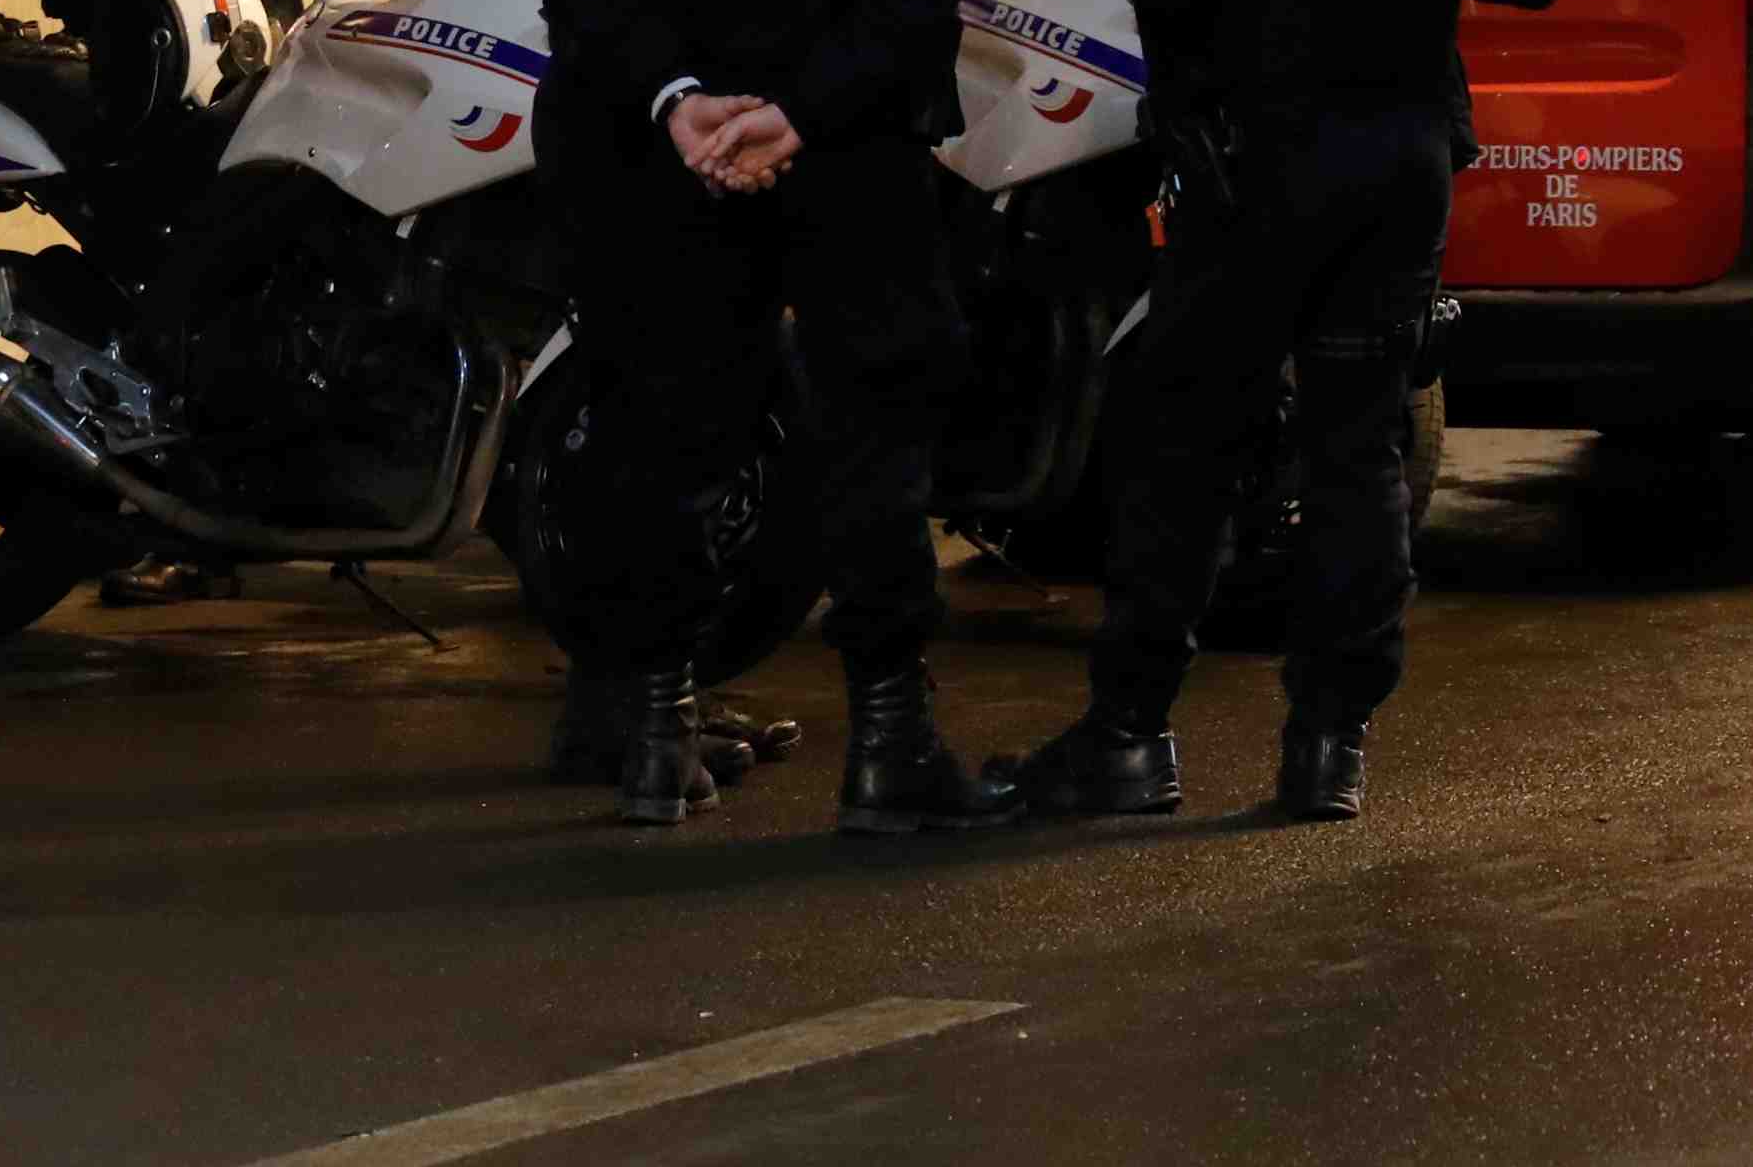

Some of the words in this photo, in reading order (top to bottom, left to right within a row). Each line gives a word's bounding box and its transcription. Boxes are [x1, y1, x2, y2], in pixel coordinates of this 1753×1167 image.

[393, 16, 497, 59] POLICE
[990, 2, 1086, 57] POLICE
[1467, 144, 1684, 172] PEURS-POMPIERS
[1545, 173, 1580, 199] DE
[1525, 202, 1598, 228] PARIS
